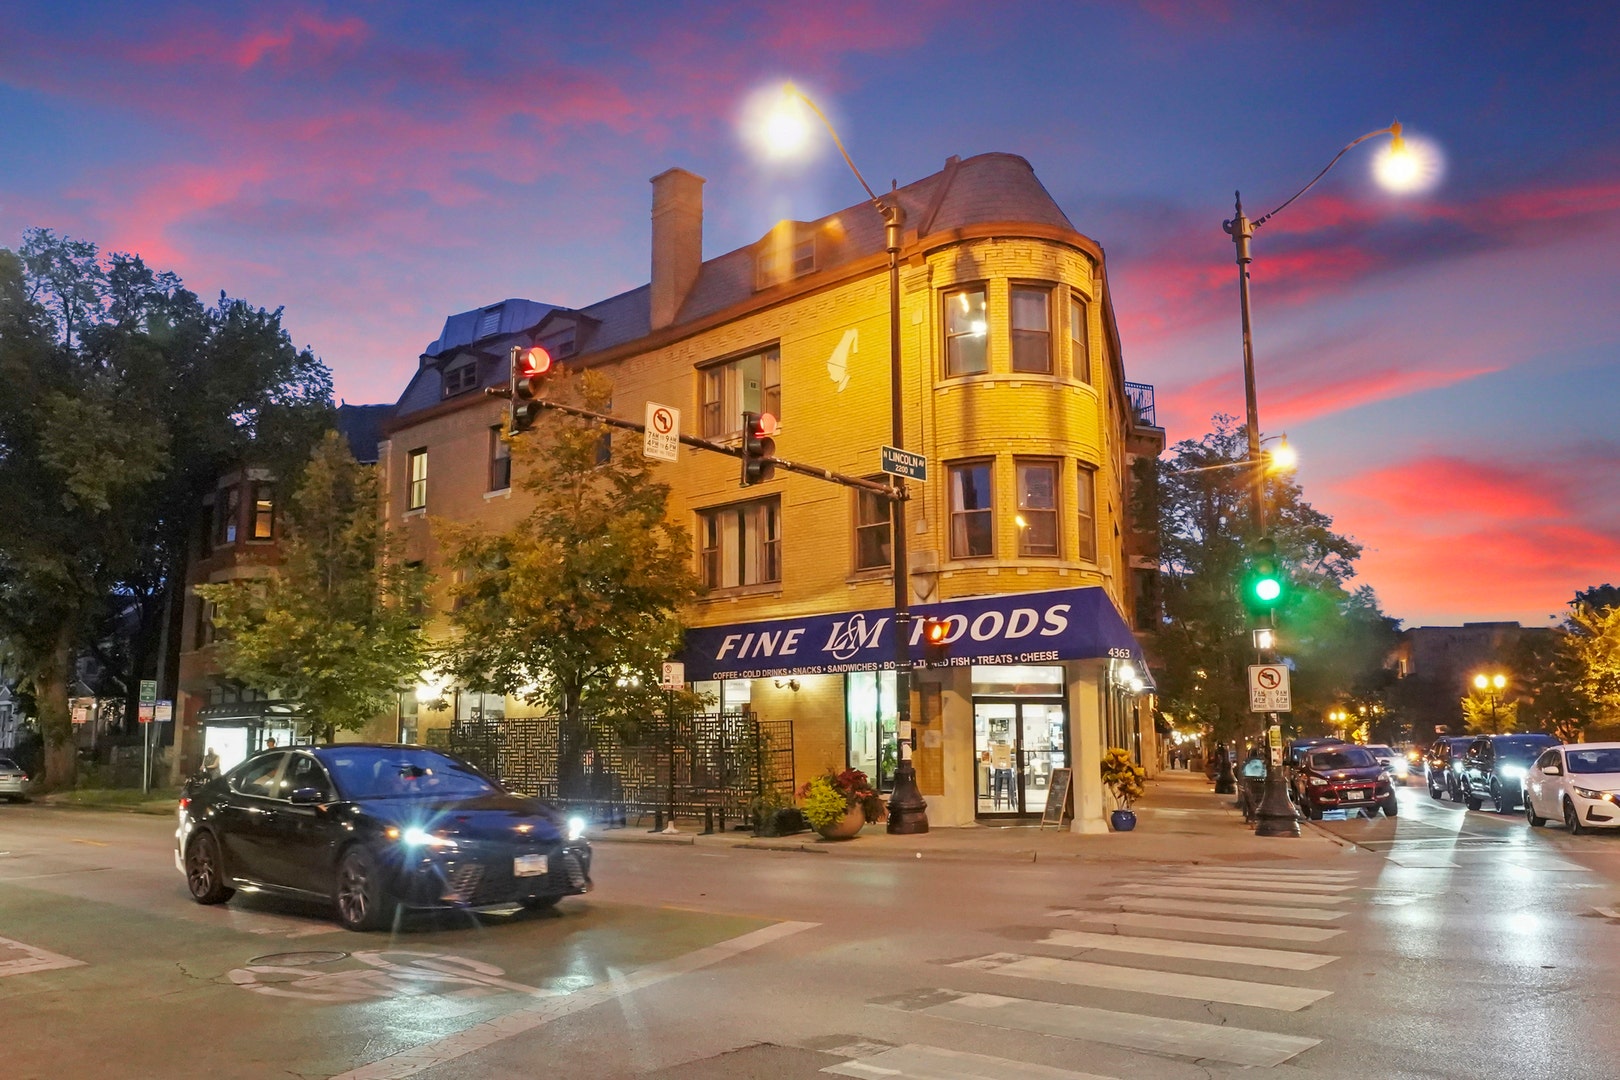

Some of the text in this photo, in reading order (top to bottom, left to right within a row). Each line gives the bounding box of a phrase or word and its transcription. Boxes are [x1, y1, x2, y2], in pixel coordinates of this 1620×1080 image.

[889, 451, 918, 468] LINCOLN
[895, 464, 909, 474] 2200
[715, 628, 806, 661] FINE
[1108, 647, 1130, 659] 4363
[712, 671, 738, 680] COFFEE
[742, 669, 761, 678] COLD
[762, 668, 787, 677] DRINKS
[792, 665, 822, 675] SNACKS
[827, 662, 878, 673] SANDWICHES
[950, 657, 970, 666] FISH
[977, 654, 1013, 665] TREATS
[1020, 650, 1059, 663] CHEESE
